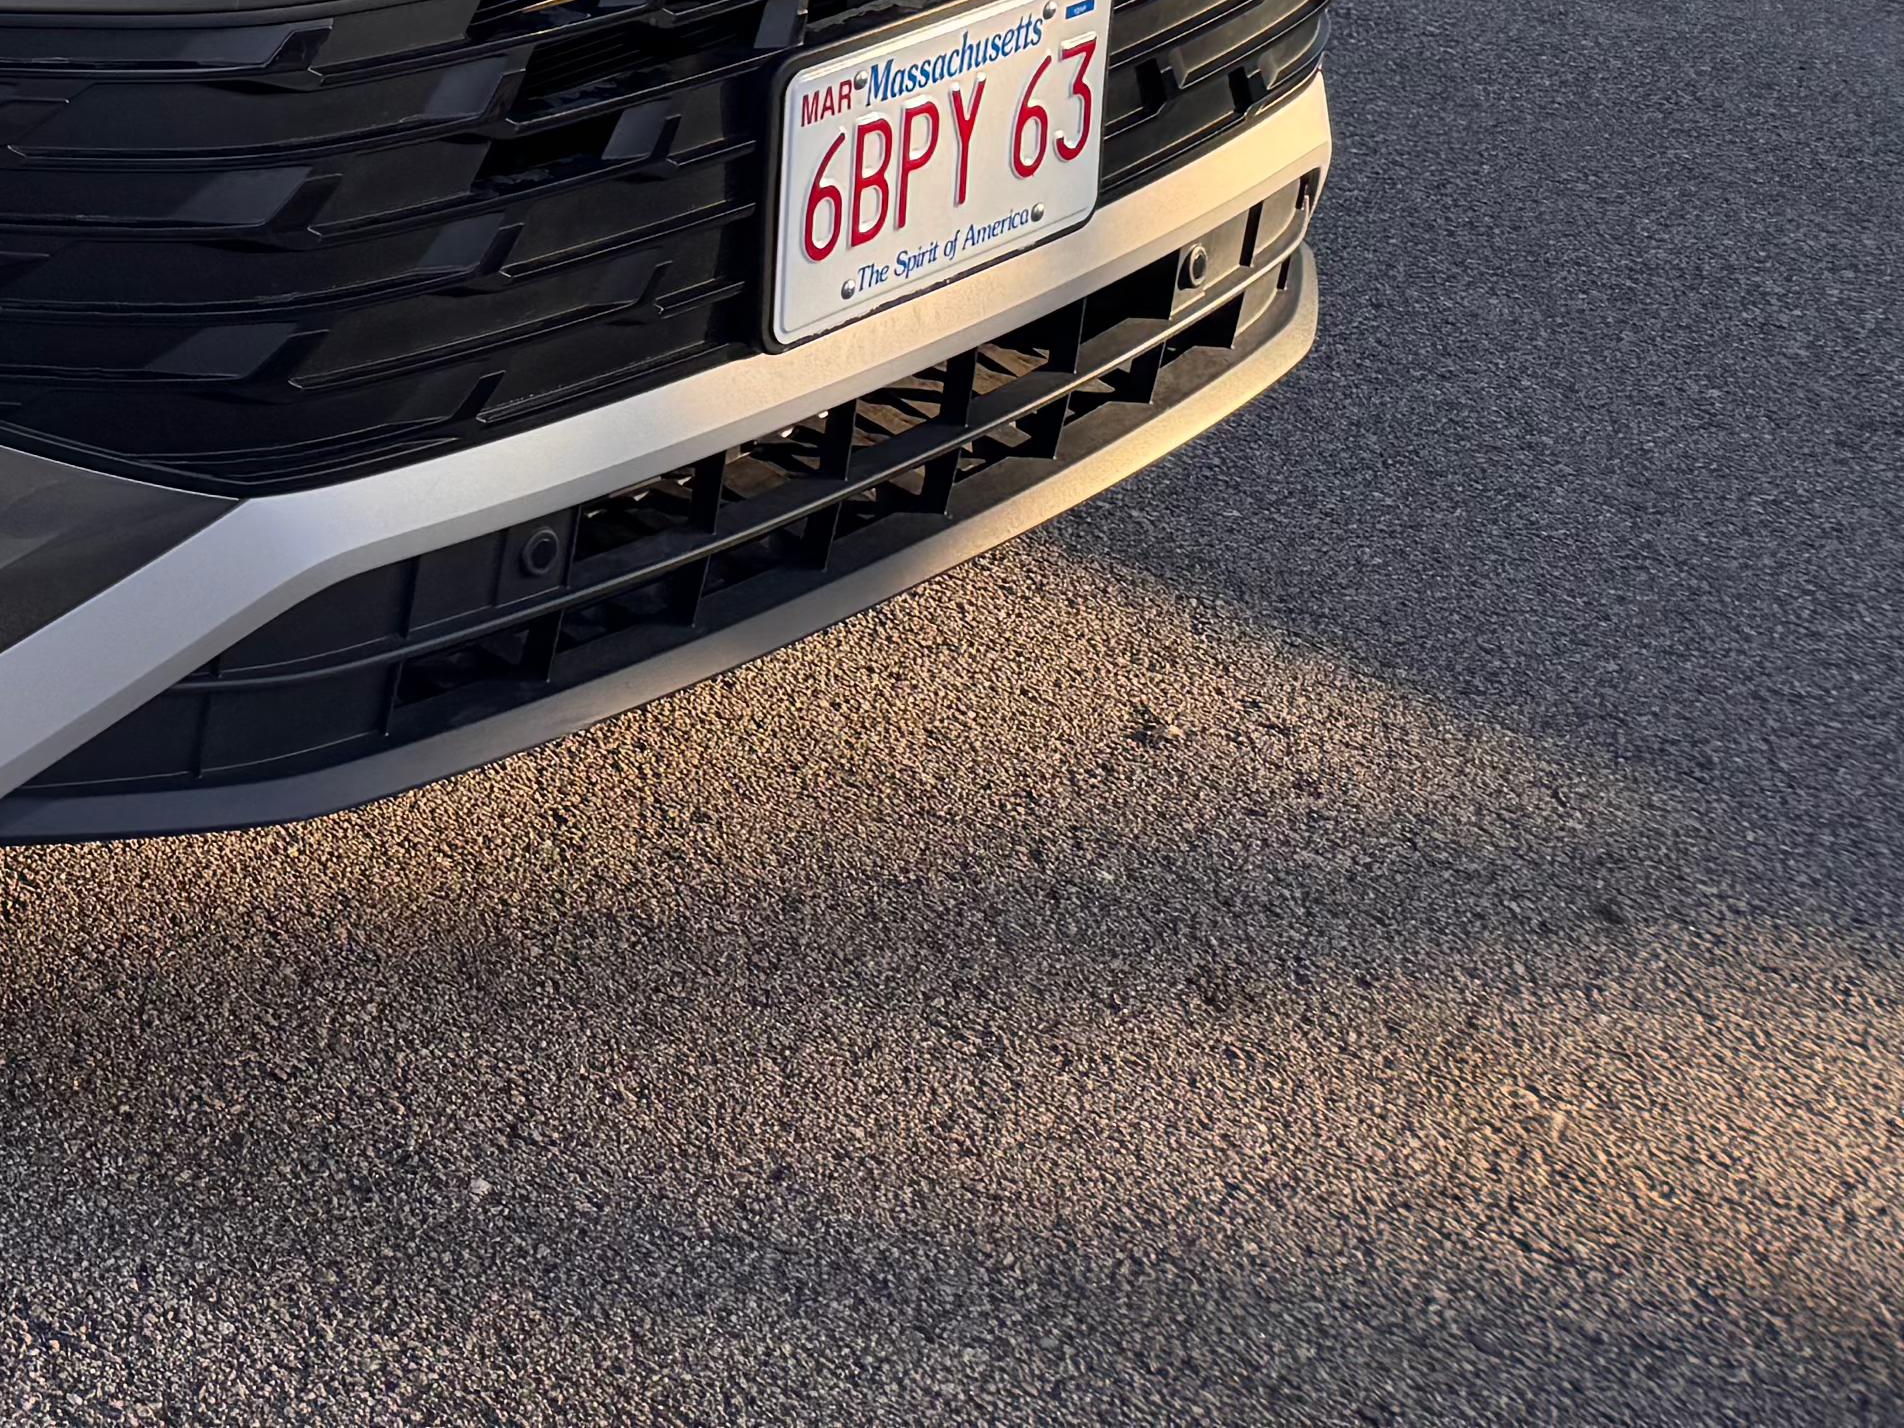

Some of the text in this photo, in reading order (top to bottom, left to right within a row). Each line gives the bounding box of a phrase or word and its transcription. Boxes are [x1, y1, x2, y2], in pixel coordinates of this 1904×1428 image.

[799, 78, 853, 128] MAR
[865, 13, 1043, 108] Massachusetts
[803, 37, 1098, 262] 6BPY 63
[857, 208, 1030, 292] The Spirit of America
